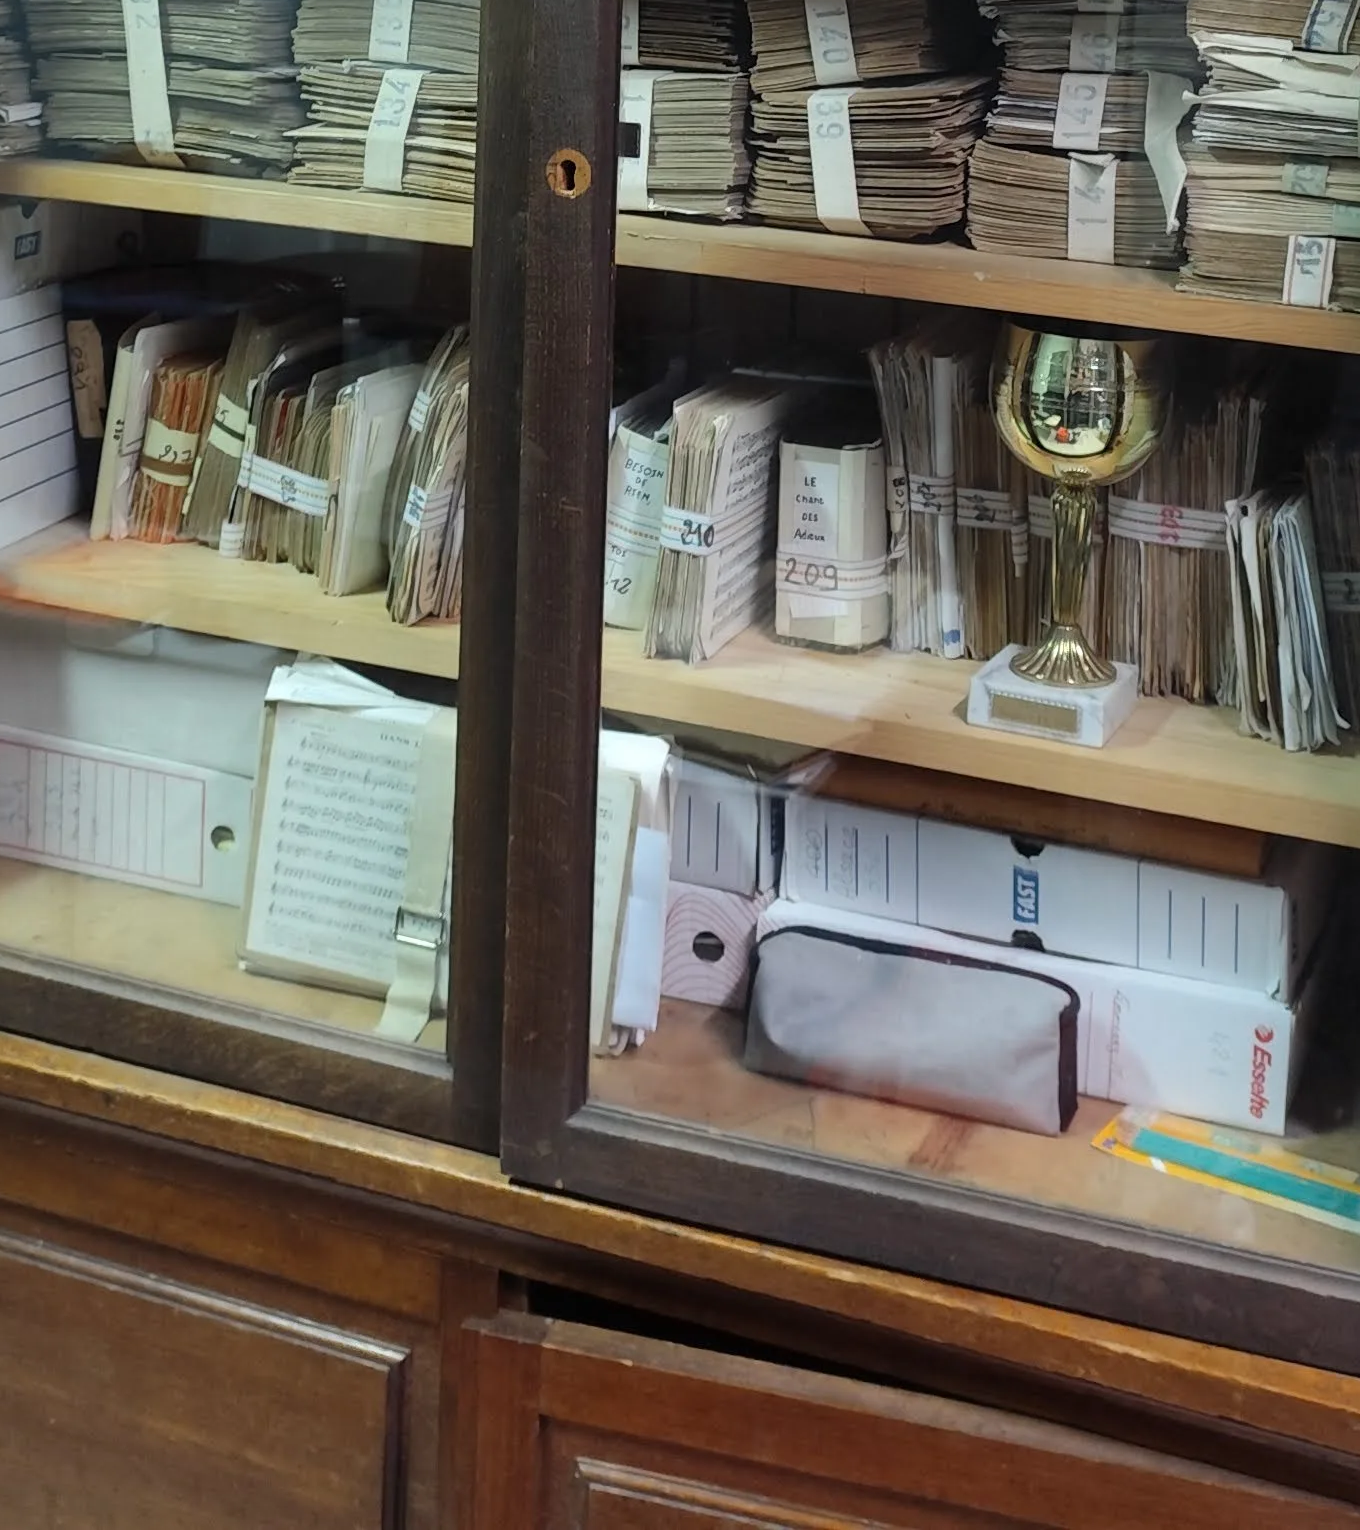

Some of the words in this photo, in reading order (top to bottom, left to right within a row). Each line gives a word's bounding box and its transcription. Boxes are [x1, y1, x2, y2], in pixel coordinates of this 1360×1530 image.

[813, 7, 851, 66] 140
[1062, 82, 1100, 139] 145
[624, 457, 665, 479] BESOIN
[804, 476, 817, 488] LE
[801, 511, 819, 522] DES
[784, 557, 839, 591] 209
[1016, 875, 1037, 919] FAST
